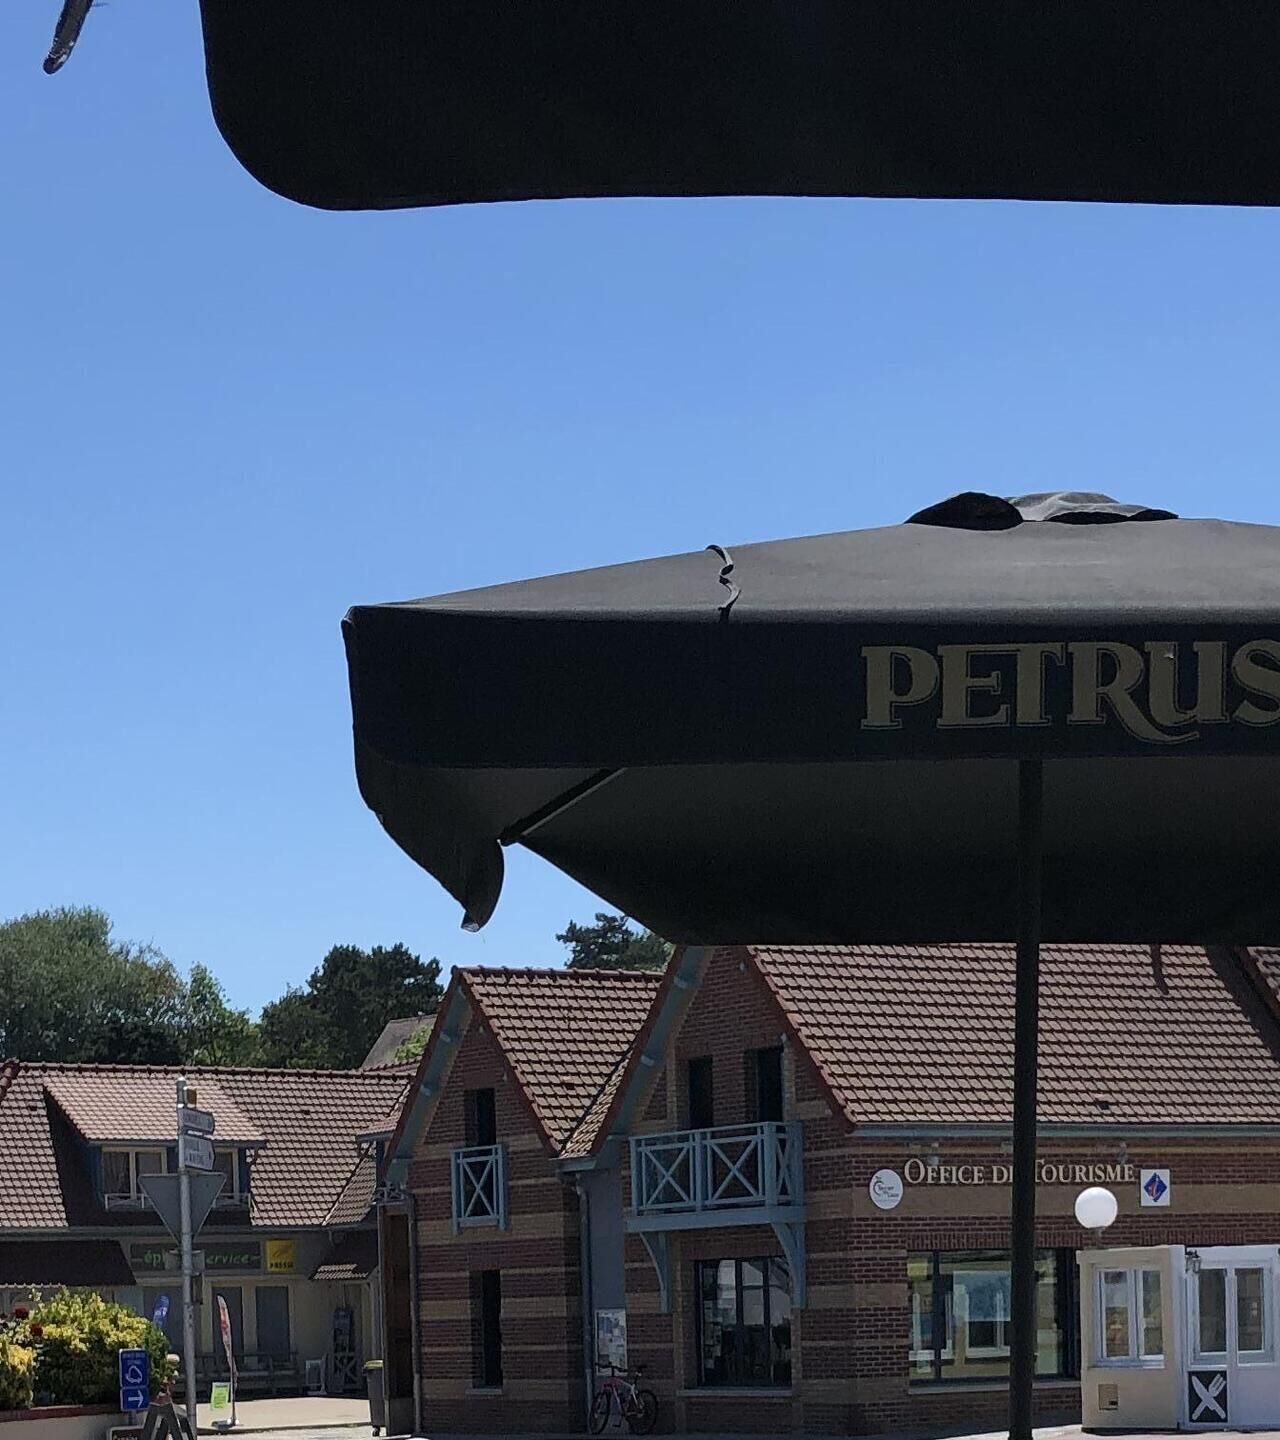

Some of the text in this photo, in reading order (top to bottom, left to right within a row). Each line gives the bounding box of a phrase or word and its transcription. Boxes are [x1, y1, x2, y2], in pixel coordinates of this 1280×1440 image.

[904, 1158, 985, 1184] OFFICE
[992, 1165, 1013, 1183] D
[206, 1253, 251, 1265] ervice
